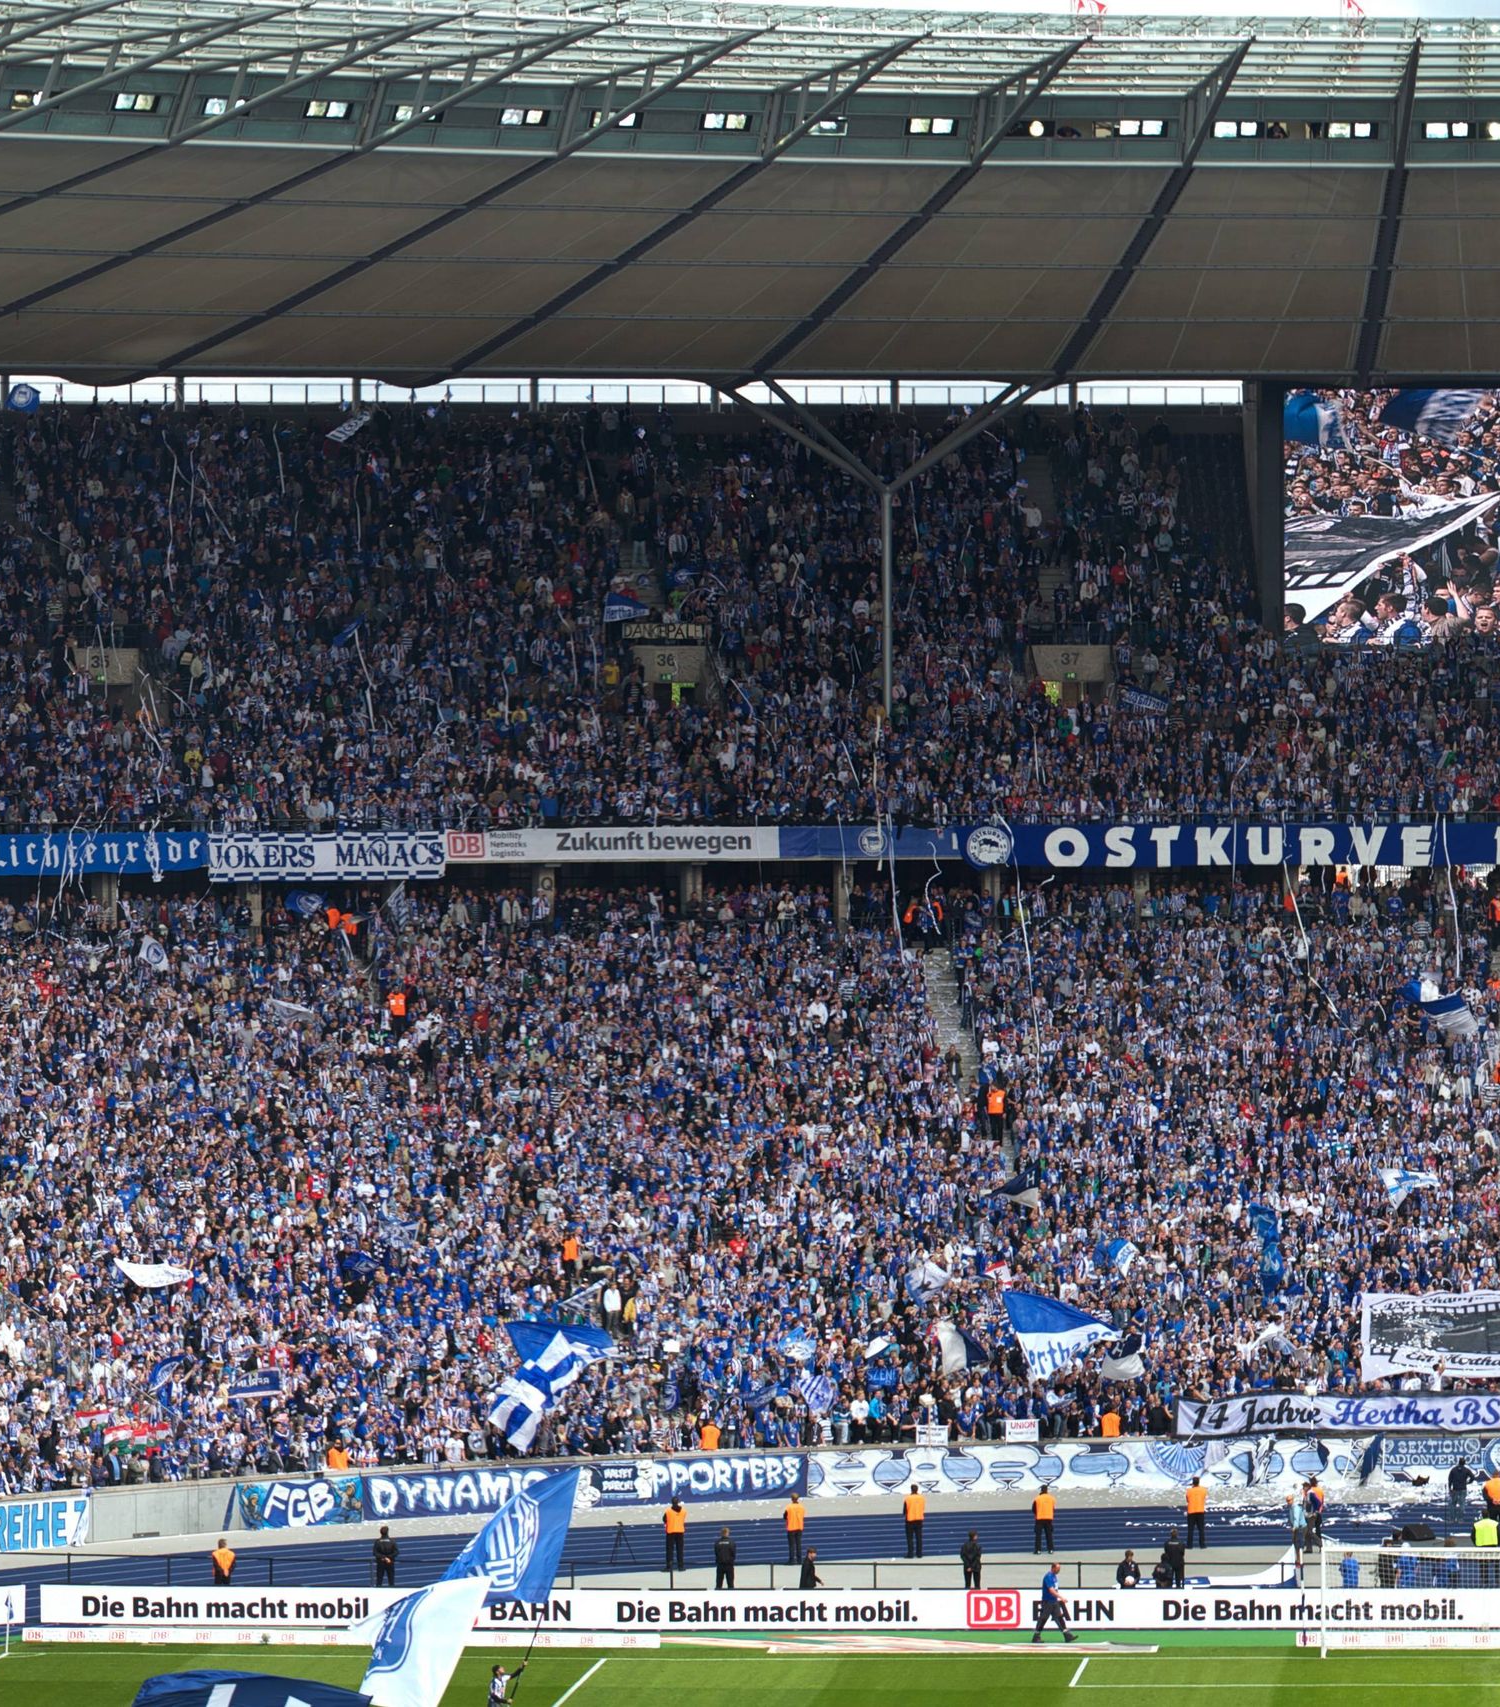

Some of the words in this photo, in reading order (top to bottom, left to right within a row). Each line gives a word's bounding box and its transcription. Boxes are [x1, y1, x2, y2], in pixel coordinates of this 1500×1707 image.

[657, 653, 675, 667] 36
[1060, 652, 1079, 666] 37
[210, 843, 316, 869] JOKERS
[336, 840, 445, 868] MANIACS
[451, 836, 481, 854] DB
[490, 840, 527, 849] Networks
[556, 832, 644, 852] Zukunft
[647, 832, 752, 855] bewegen
[1044, 825, 1433, 868] OSTKURVE
[1010, 1421, 1036, 1430] UNION
[1193, 1403, 1230, 1430] 14
[1240, 1398, 1323, 1433] Jahre
[1330, 1398, 1444, 1426] Hertha
[1397, 1440, 1465, 1454] SEKTION
[263, 1477, 337, 1528] FGB
[81, 1595, 125, 1617] Die
[132, 1596, 199, 1618] Bahn
[206, 1597, 288, 1619] macht
[490, 1600, 571, 1621] BAHN
[616, 1600, 660, 1622] Die
[668, 1600, 736, 1622] Bahn
[743, 1600, 828, 1622] macht
[973, 1597, 1014, 1622] DB
[1162, 1598, 1207, 1621] Die
[1214, 1598, 1283, 1621] Bahn
[1289, 1598, 1373, 1621] macht
